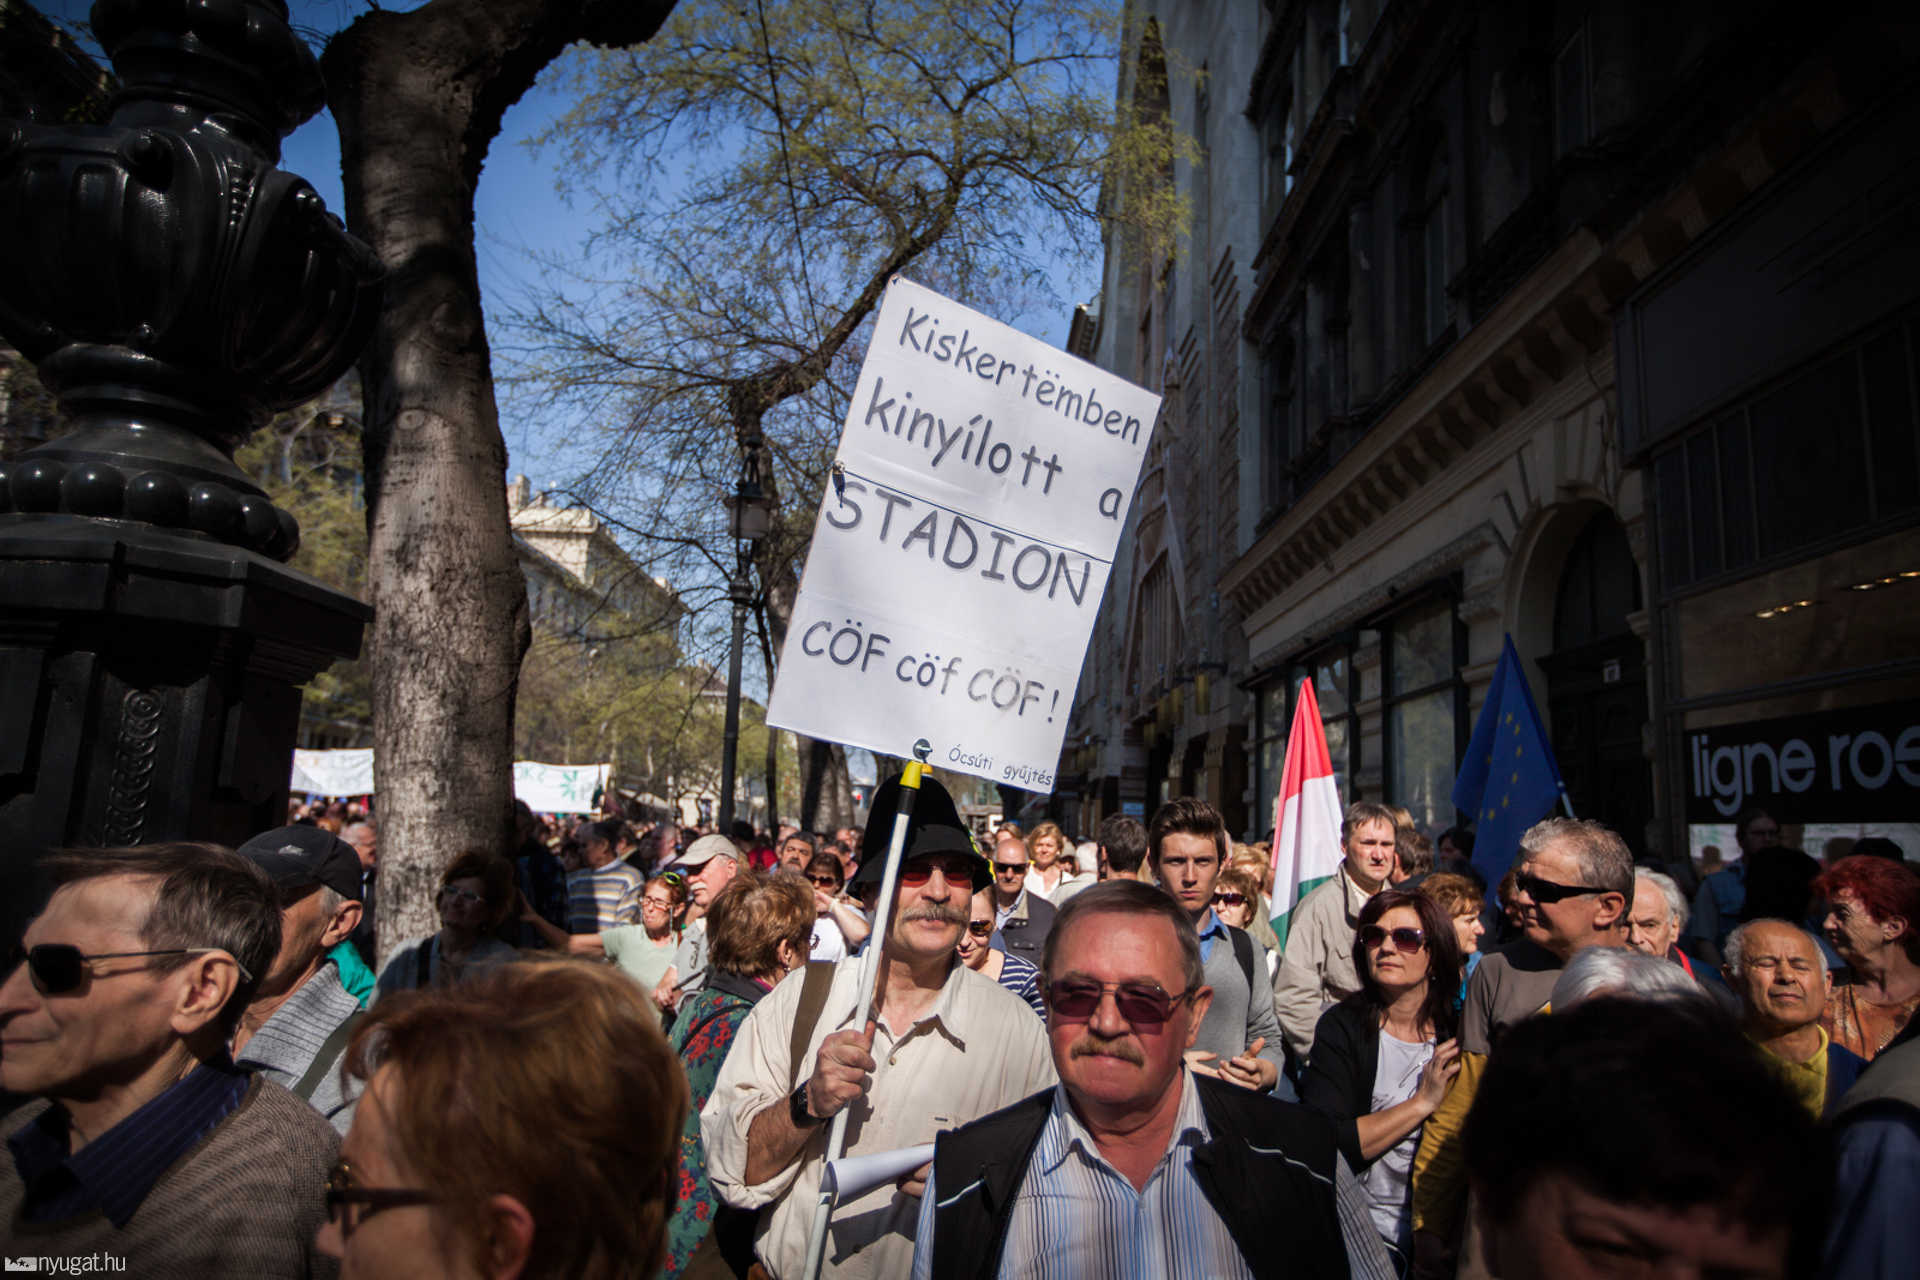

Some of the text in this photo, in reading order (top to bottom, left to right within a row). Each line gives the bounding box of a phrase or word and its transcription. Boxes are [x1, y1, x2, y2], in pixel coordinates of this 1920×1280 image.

[865, 377, 1123, 520] kinyílott a
[826, 482, 1091, 606] STADION
[802, 619, 891, 672] CÖF
[896, 654, 963, 695] cöf
[1691, 734, 1816, 816] ligne
